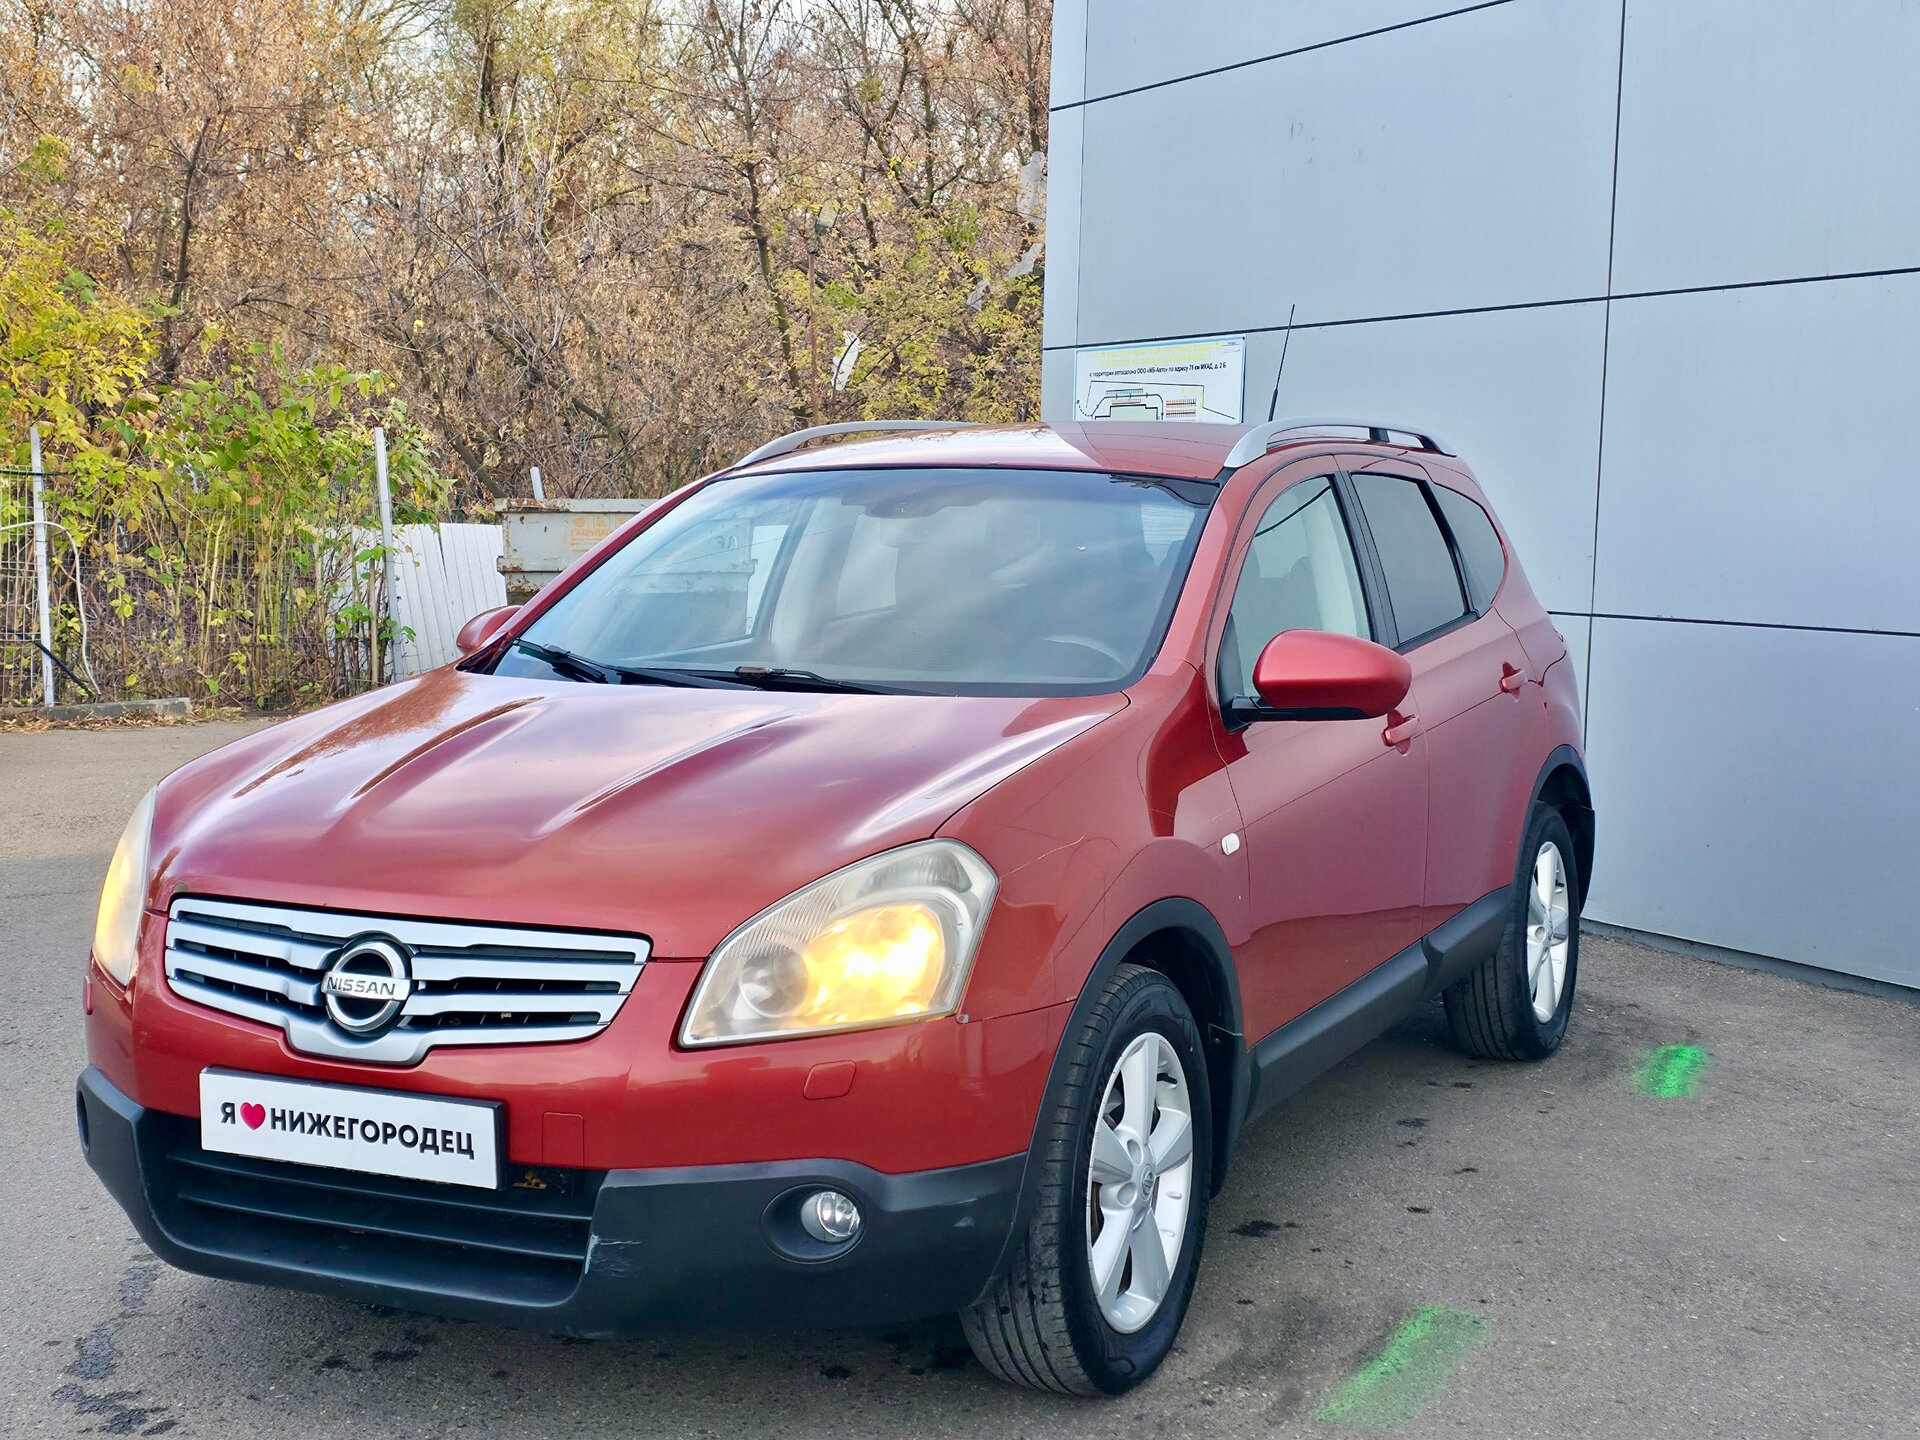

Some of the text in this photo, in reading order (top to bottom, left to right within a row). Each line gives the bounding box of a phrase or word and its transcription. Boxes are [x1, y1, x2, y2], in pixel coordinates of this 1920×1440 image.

[326, 976, 396, 996] NISSAN
[220, 1101, 475, 1160] Я НИЖЕГОРОДЕЦ
